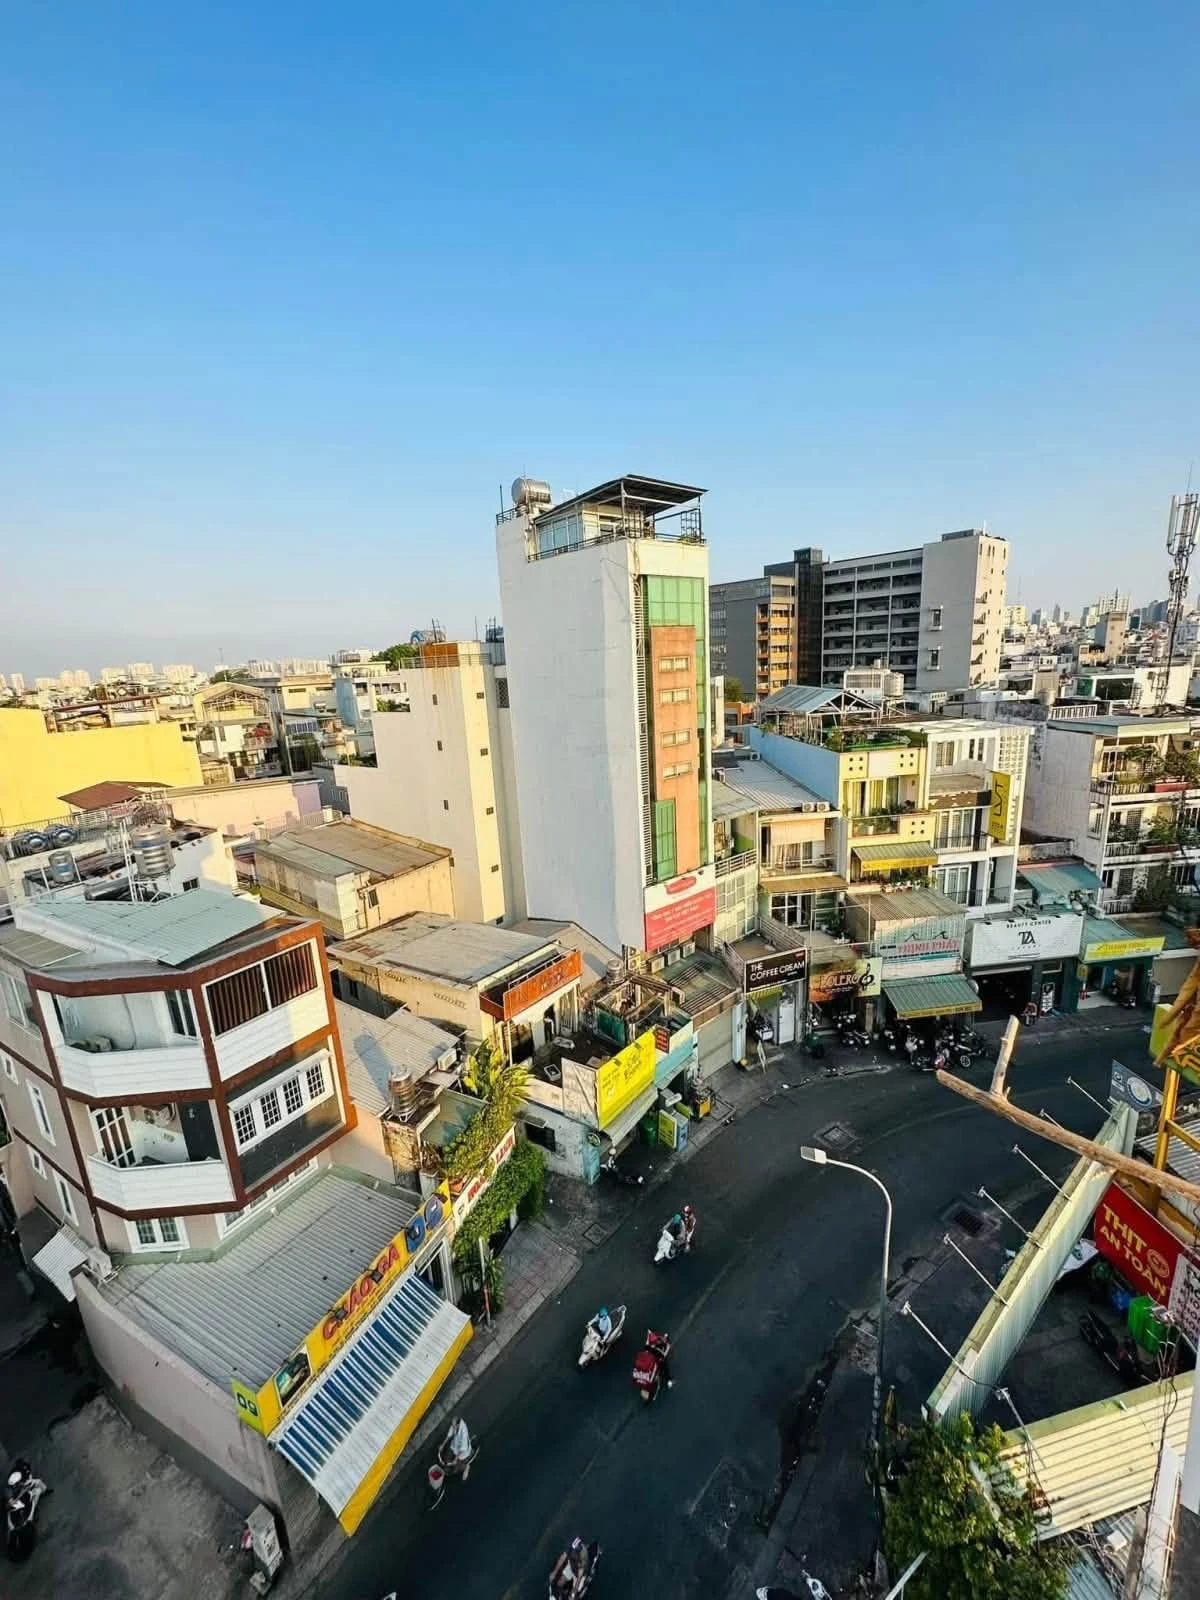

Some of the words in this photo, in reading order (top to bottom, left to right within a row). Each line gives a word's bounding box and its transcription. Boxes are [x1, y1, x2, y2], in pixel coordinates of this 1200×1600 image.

[750, 962, 764, 972] THE
[750, 967, 779, 981] COFFEE
[779, 960, 805, 974] CREAM
[1100, 1225, 1121, 1251] AN
